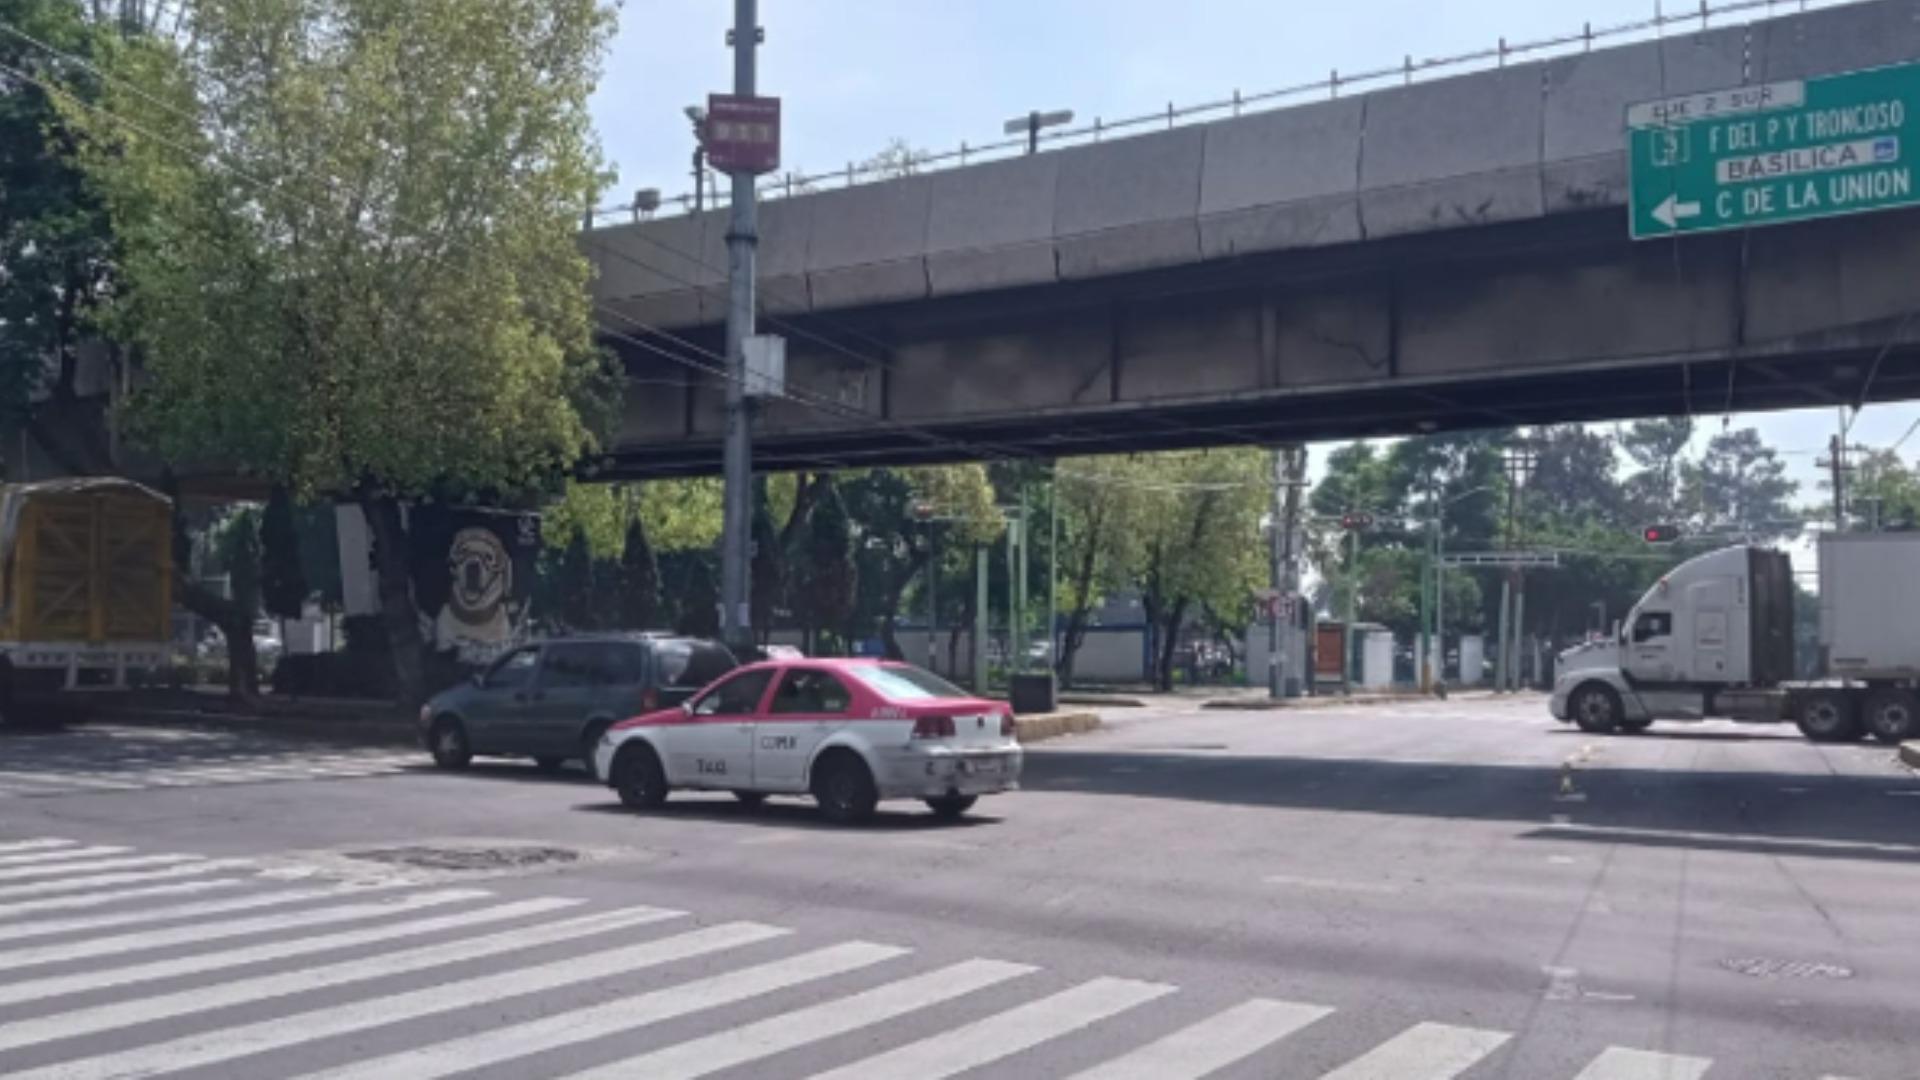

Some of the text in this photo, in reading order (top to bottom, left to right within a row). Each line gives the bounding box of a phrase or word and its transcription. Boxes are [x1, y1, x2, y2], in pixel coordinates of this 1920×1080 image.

[1705, 97, 1716, 111] 2
[1731, 86, 1772, 107] SUR
[1709, 125, 1720, 152] F
[1727, 121, 1758, 150] DEL
[1766, 118, 1779, 144] P
[1786, 115, 1799, 142] Y
[1805, 99, 1905, 140] TRONCOSO
[1728, 144, 1858, 180] BASILICA
[1716, 167, 1911, 218] C DE LA UNION
